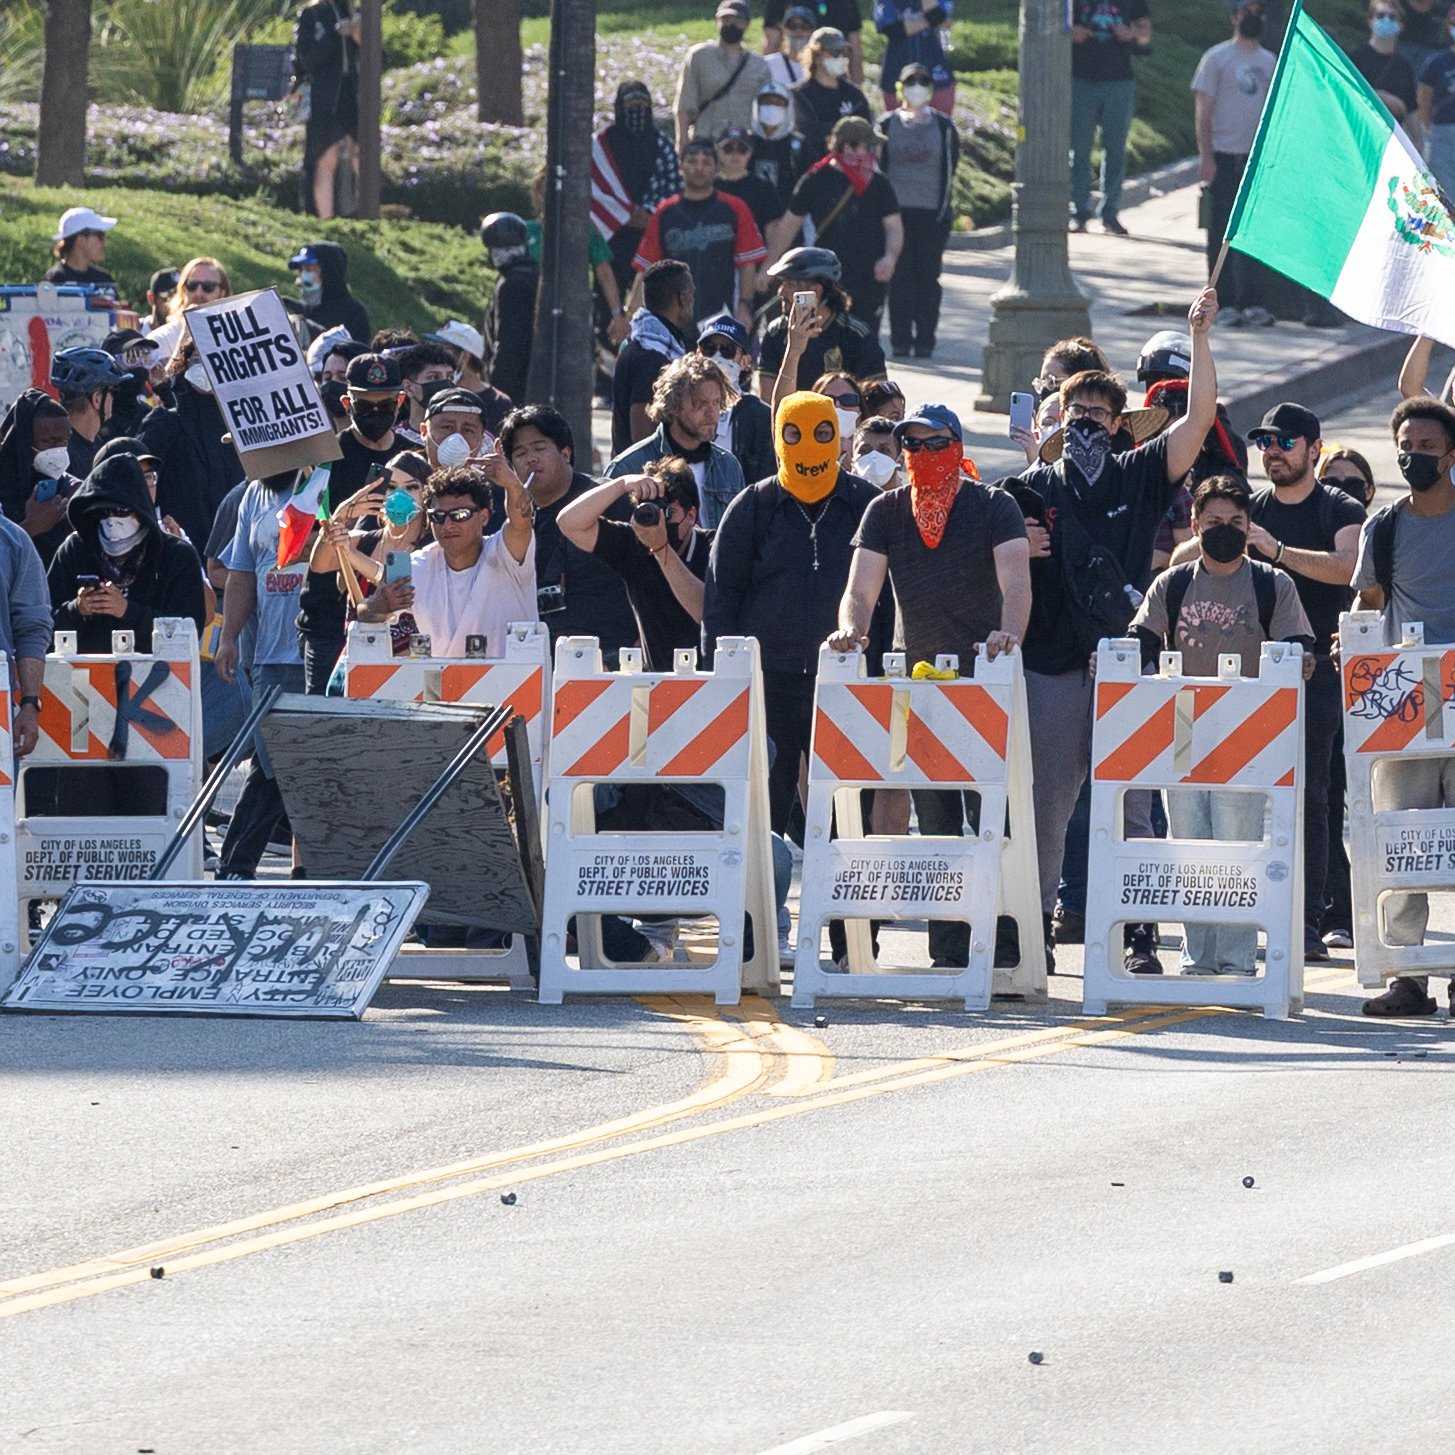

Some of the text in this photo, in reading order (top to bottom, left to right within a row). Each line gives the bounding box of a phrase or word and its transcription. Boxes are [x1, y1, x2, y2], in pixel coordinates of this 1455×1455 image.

[206, 305, 271, 347] FULL
[206, 333, 298, 385] RIGHTS
[227, 383, 319, 429] FOR ALL
[238, 411, 325, 446] IMMIGRANTS!
[795, 459, 831, 476] drew
[1400, 830, 1421, 841] CITY
[1424, 829, 1436, 840] OF
[40, 839, 141, 850] CITY OF LOS ANGELES
[1385, 842, 1417, 855] DEPT.
[1420, 841, 1435, 854] OF
[25, 850, 156, 864] DEPT. OF PUBLIC WORKS
[594, 855, 695, 866] CITY OF LOS ANGELES
[1385, 854, 1444, 872] STREET
[24, 864, 81, 881] STREET
[579, 866, 709, 879] DEPT. OF PUBLIC WORKS
[1139, 863, 1242, 876] CITY OF LOS ANGELES
[577, 880, 709, 896] STREET SERVICES
[1123, 874, 1257, 890] DEPT. OF PUBLIC WORKS
[151, 892, 341, 901] DEPARTMENT OF GENERAL SERVICES
[1121, 888, 1258, 907] STREET SERVICES
[163, 900, 317, 910] SECURITY SERVICES DIVISION
[74, 965, 145, 981] ONLY
[65, 984, 223, 1000] EMPLOYEE
